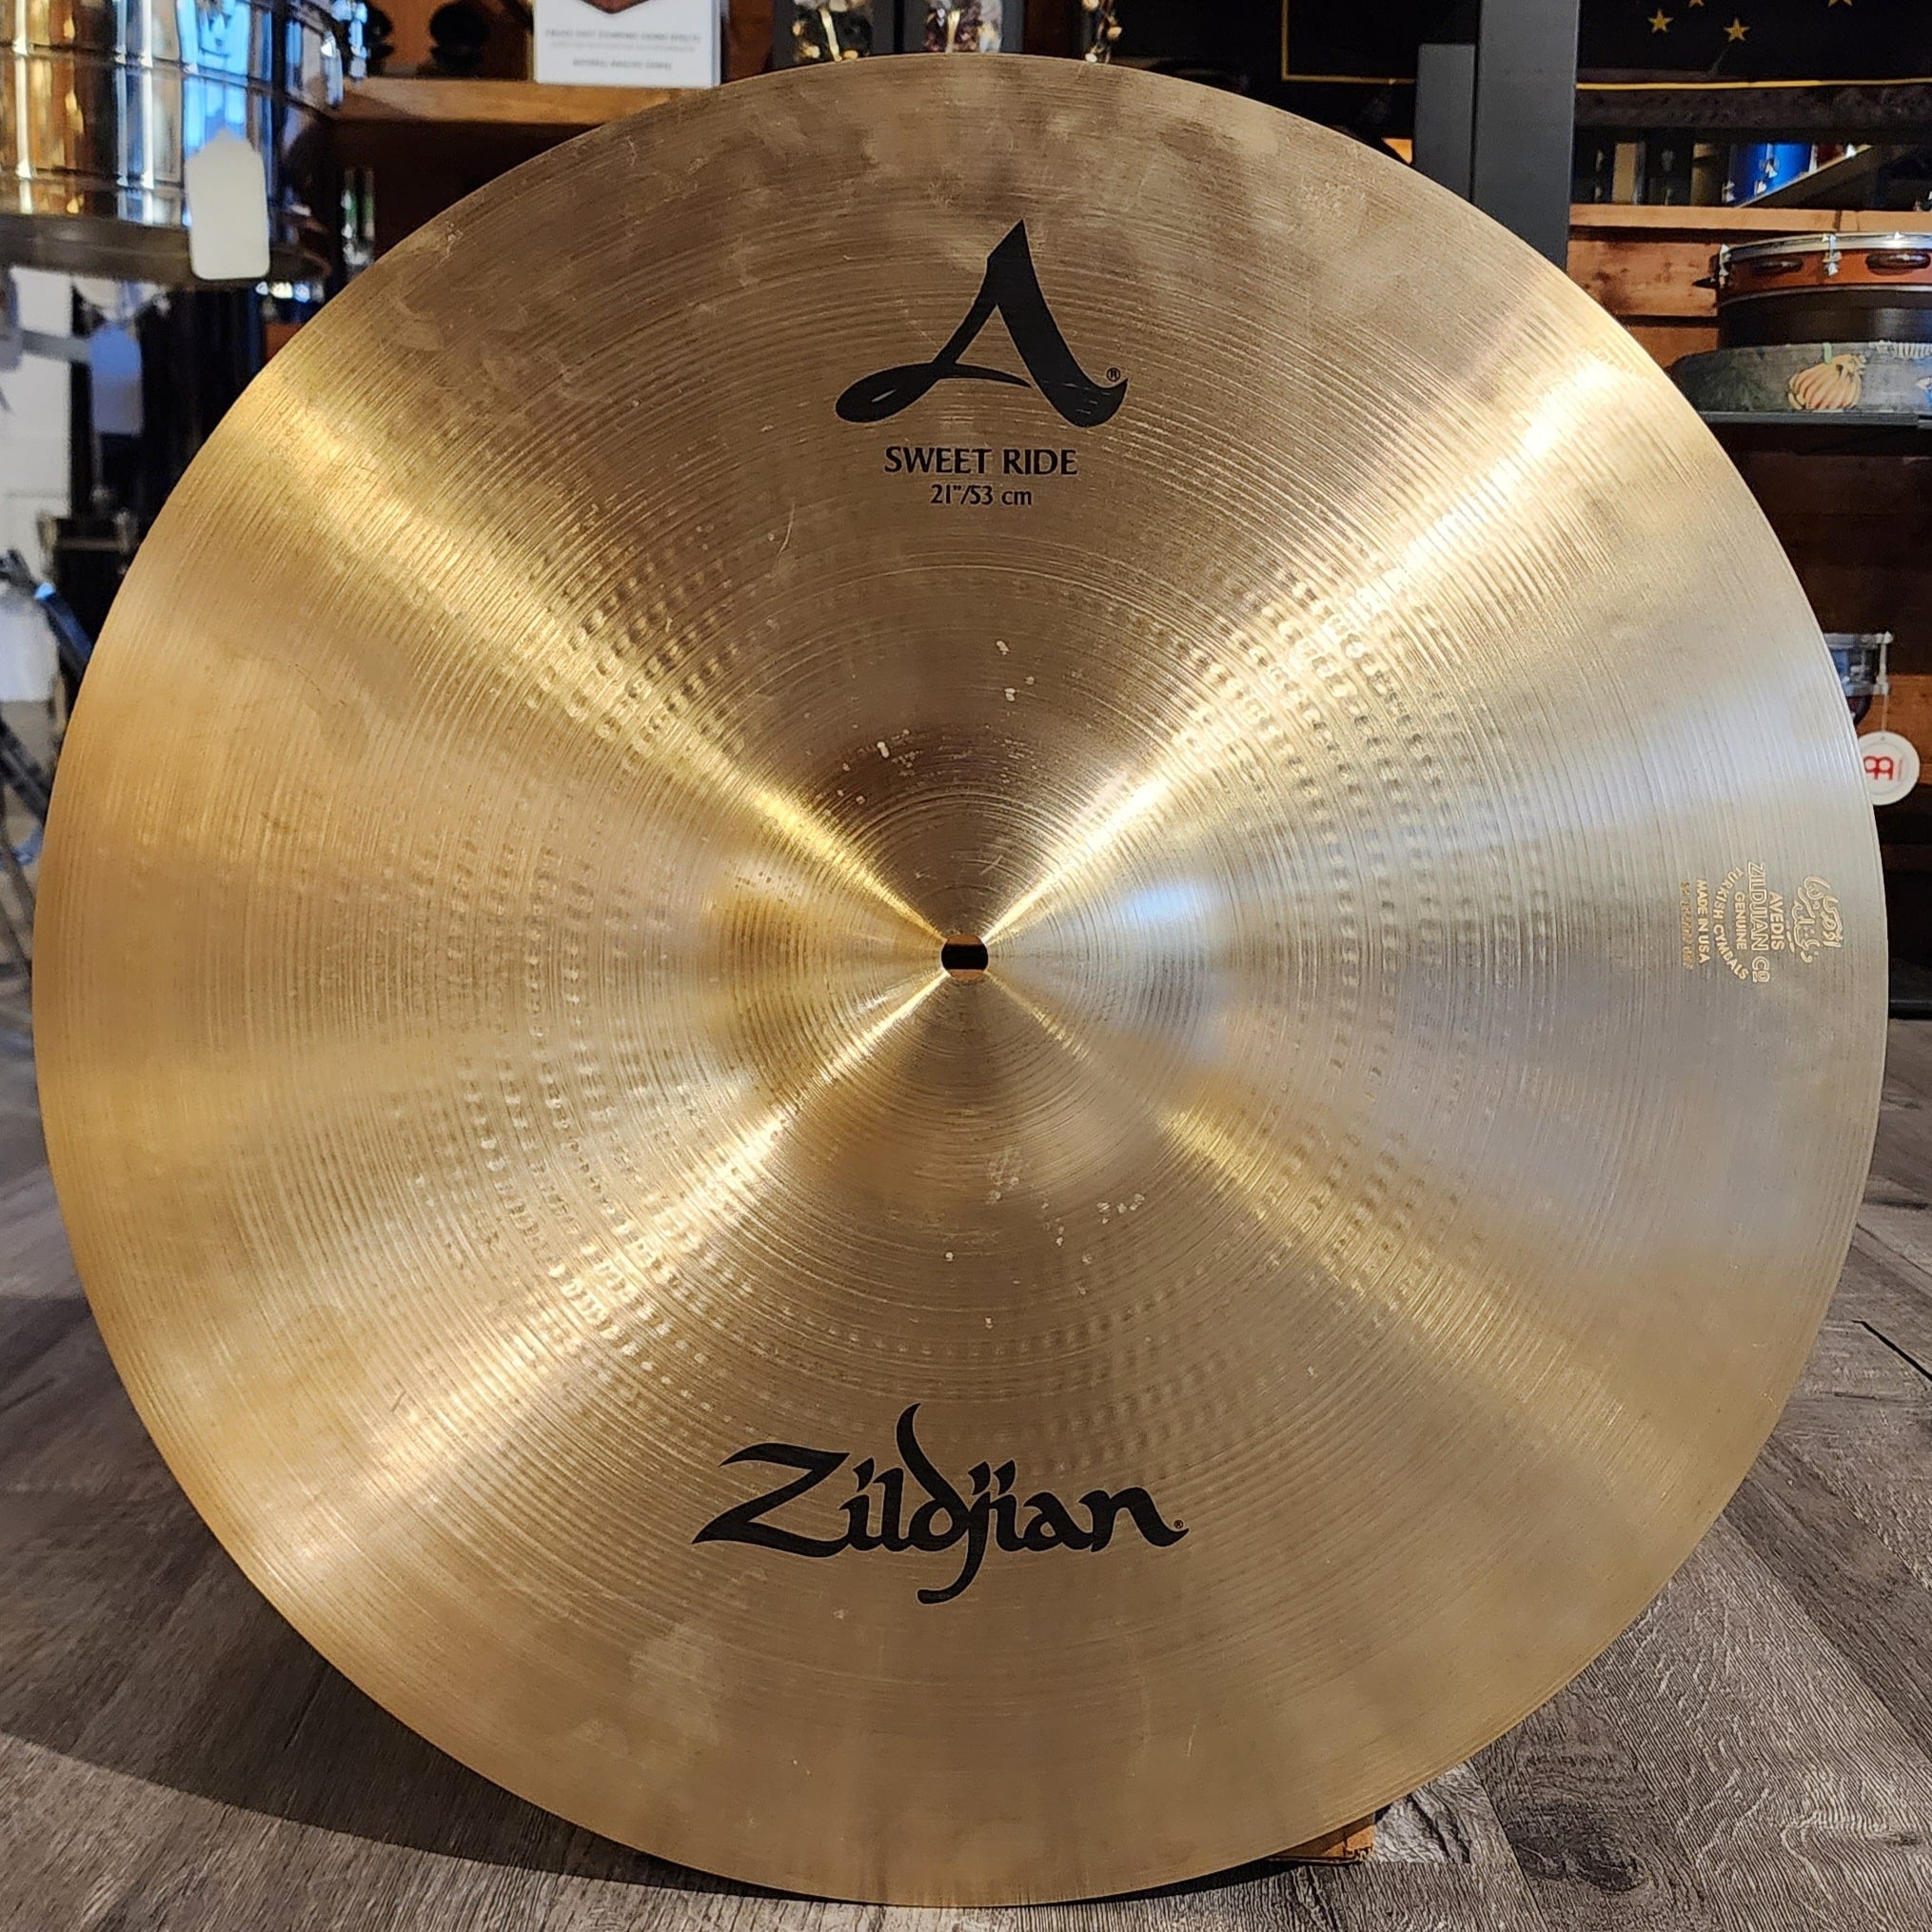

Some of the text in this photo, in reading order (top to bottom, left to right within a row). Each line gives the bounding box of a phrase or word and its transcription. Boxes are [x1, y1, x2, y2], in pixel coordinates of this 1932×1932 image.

[835, 219, 1129, 428] A
[884, 445, 1078, 476] SWEET RIDE
[1001, 488, 1033, 505] cm
[1696, 878, 1710, 964] MADE IN USA
[1713, 866, 1749, 979] TURKISH CYMBALS
[1734, 890, 1747, 950] GENUINE
[1747, 860, 1769, 951] ZILDJIAN
[1768, 890, 1784, 951] AVEDIS
[691, 1403, 1189, 1605] Zildjian
